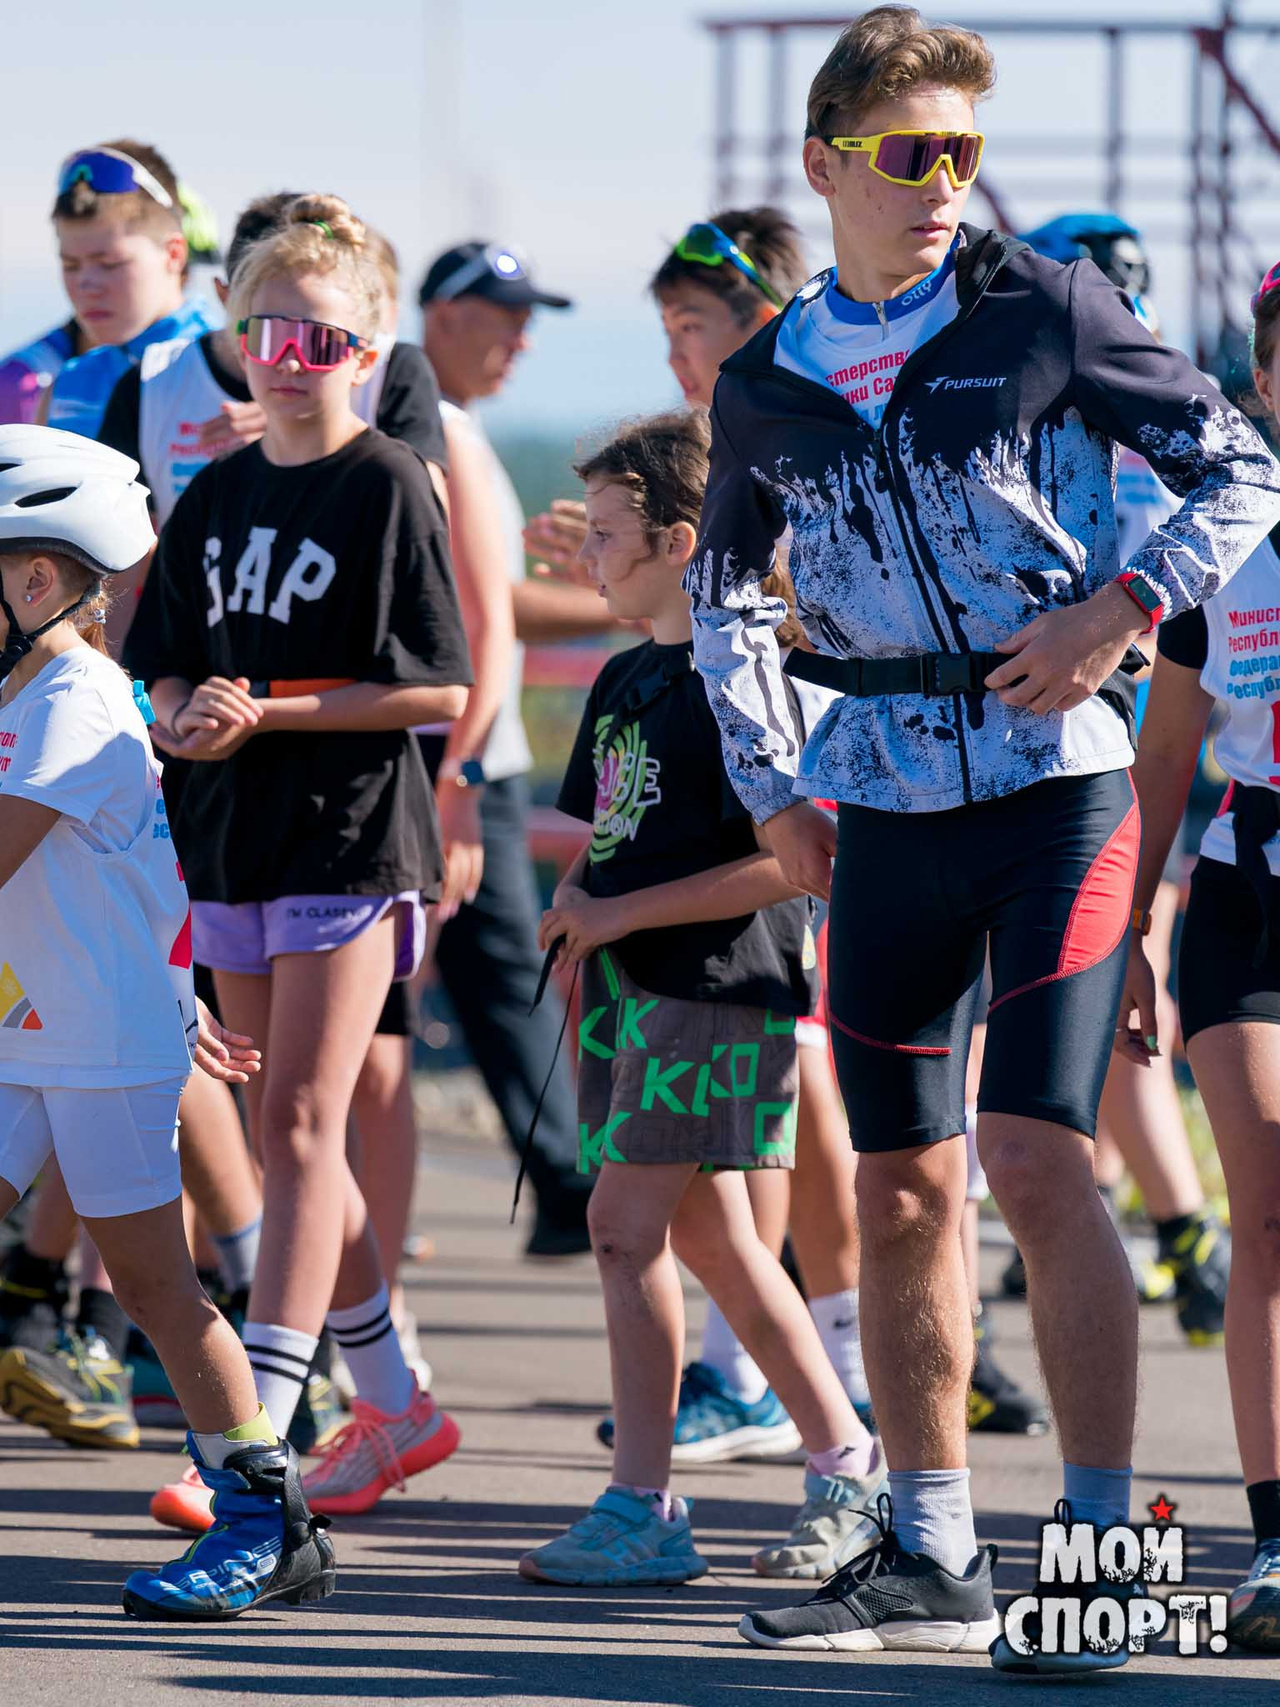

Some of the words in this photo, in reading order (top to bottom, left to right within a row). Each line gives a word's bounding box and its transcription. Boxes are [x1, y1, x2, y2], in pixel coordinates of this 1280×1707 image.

[873, 376, 897, 396] Са
[944, 377, 1007, 391] PURSUIT
[1228, 628, 1280, 655] Республ
